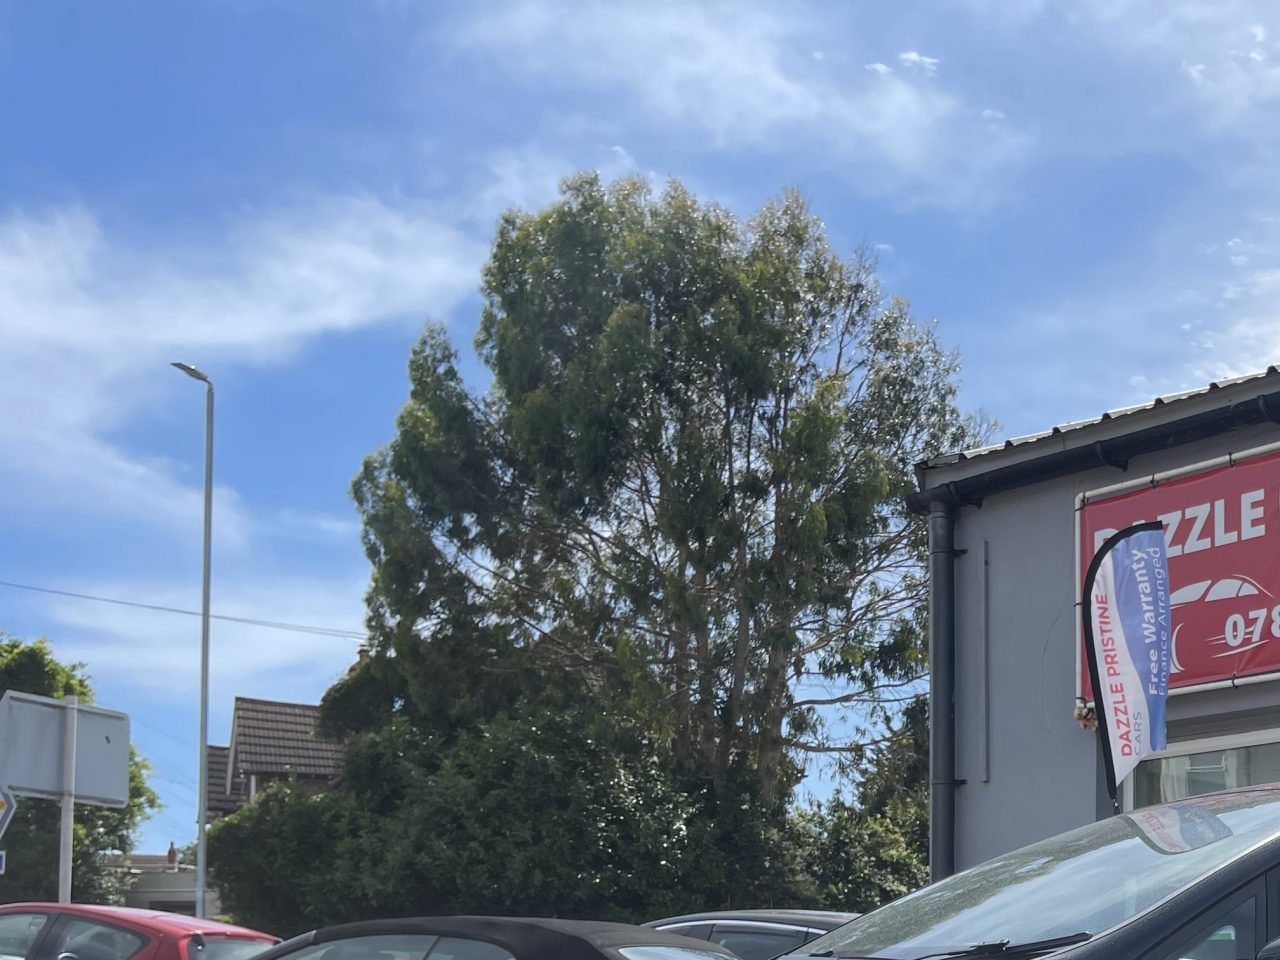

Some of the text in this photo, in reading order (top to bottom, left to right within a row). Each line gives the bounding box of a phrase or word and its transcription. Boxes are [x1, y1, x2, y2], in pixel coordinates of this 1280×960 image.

[1094, 489, 1265, 558] ZZLE
[1095, 593, 1133, 757] DAZZLE PRISTINE
[1131, 549, 1159, 695] Free Warranty
[1146, 547, 1168, 696] Finance Arranged
[1133, 711, 1142, 756] CARS
